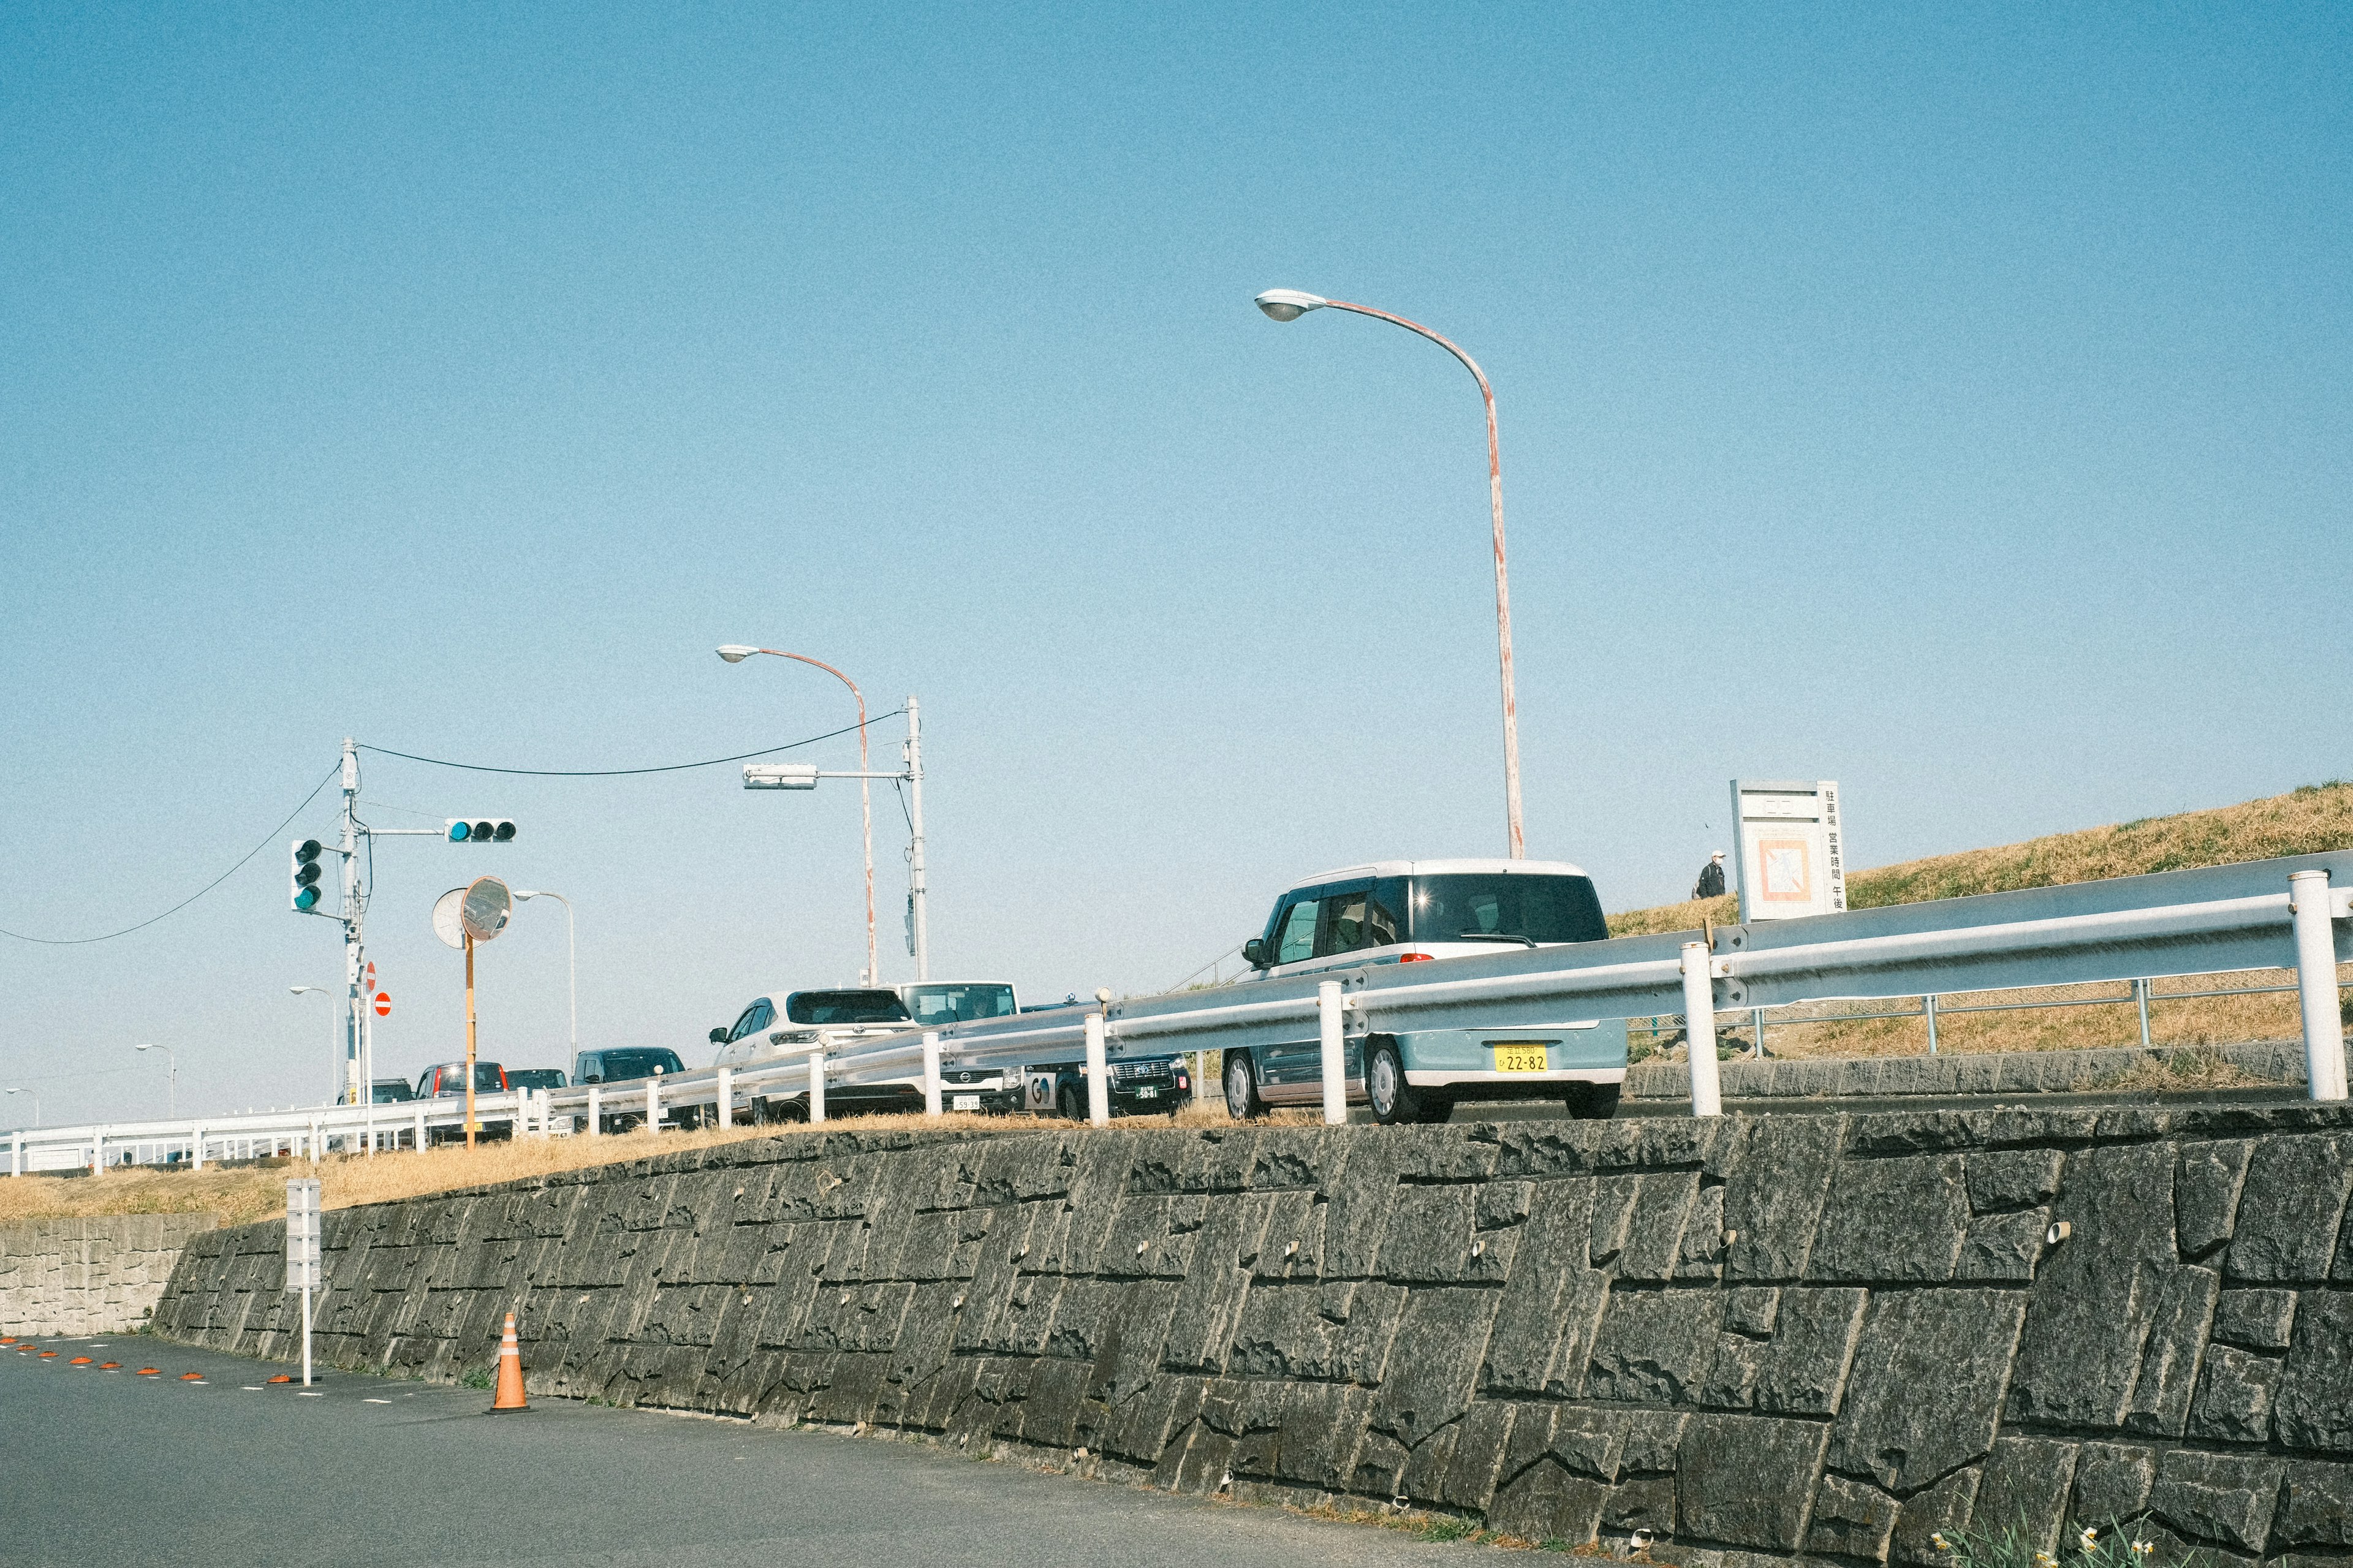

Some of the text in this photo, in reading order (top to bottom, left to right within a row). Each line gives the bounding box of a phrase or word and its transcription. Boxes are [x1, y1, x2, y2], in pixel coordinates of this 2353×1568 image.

[1825, 791, 1843, 912] 駐車場 営業時間 午後
[1507, 1056, 1544, 1070] 22-82
[1140, 1089, 1157, 1099] 50-81
